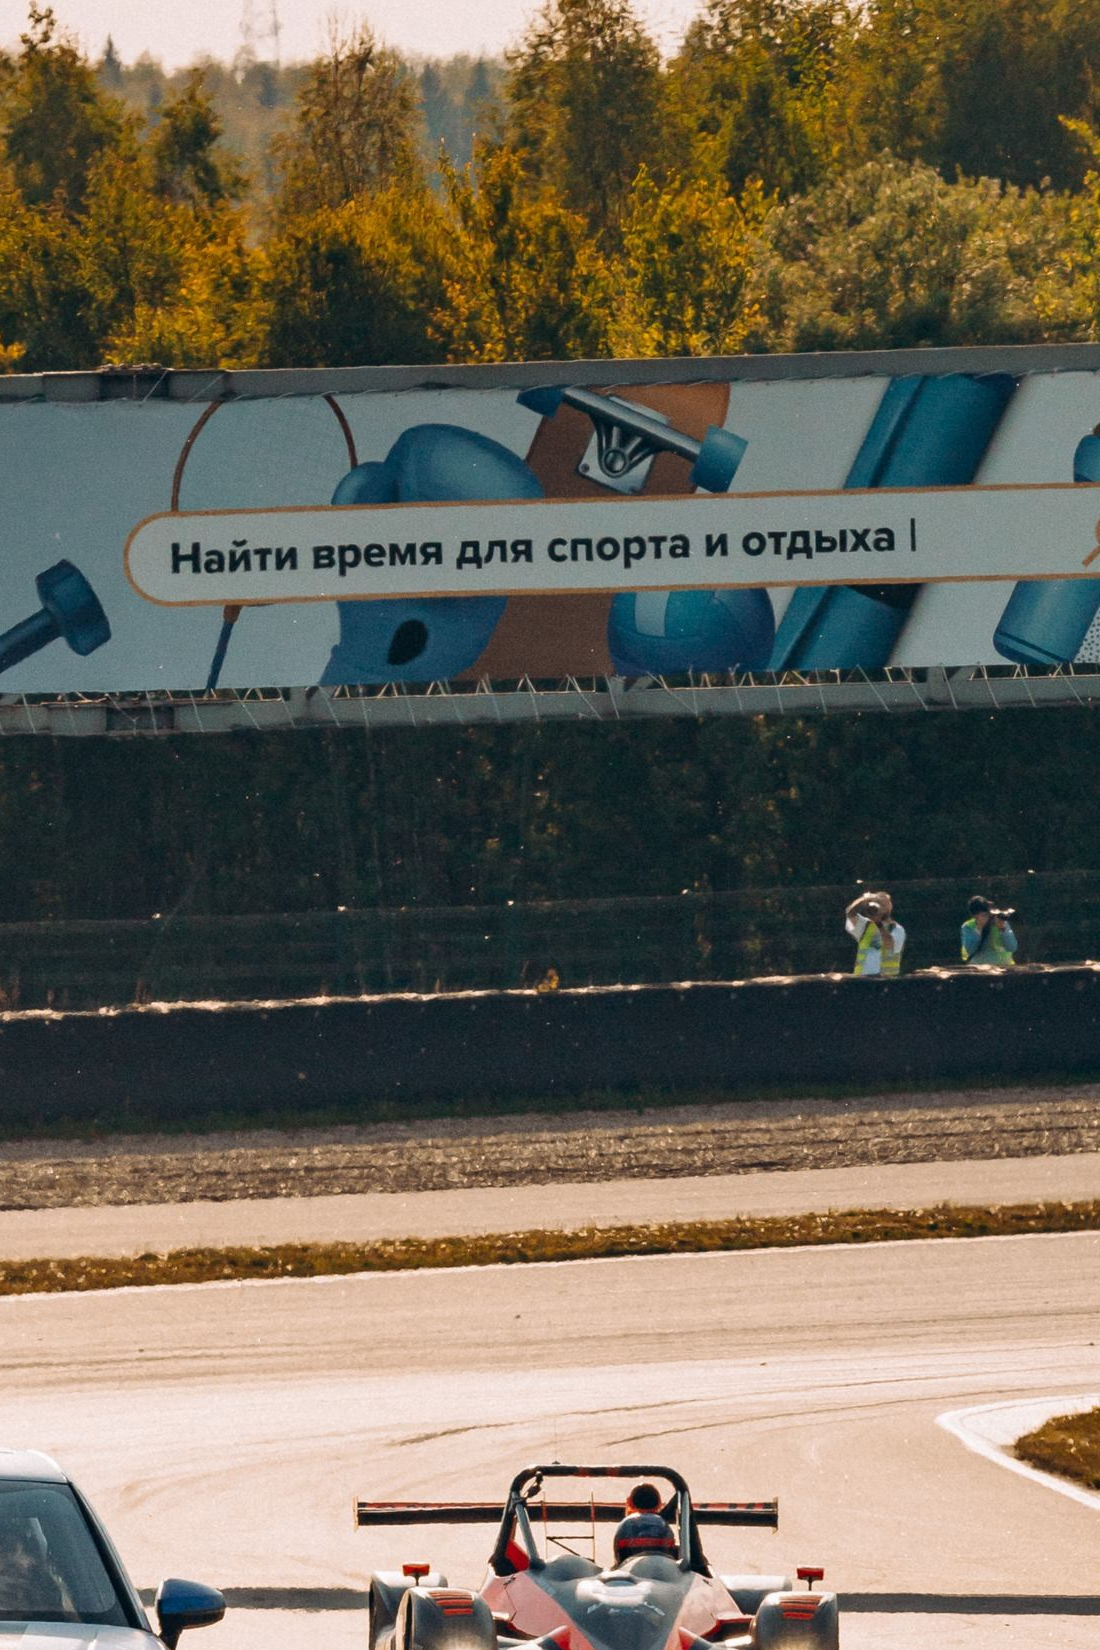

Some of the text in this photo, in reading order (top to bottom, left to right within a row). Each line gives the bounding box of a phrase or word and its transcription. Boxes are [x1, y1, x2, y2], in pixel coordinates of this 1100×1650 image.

[171, 526, 896, 577] Найти время для спорта и отдыха
